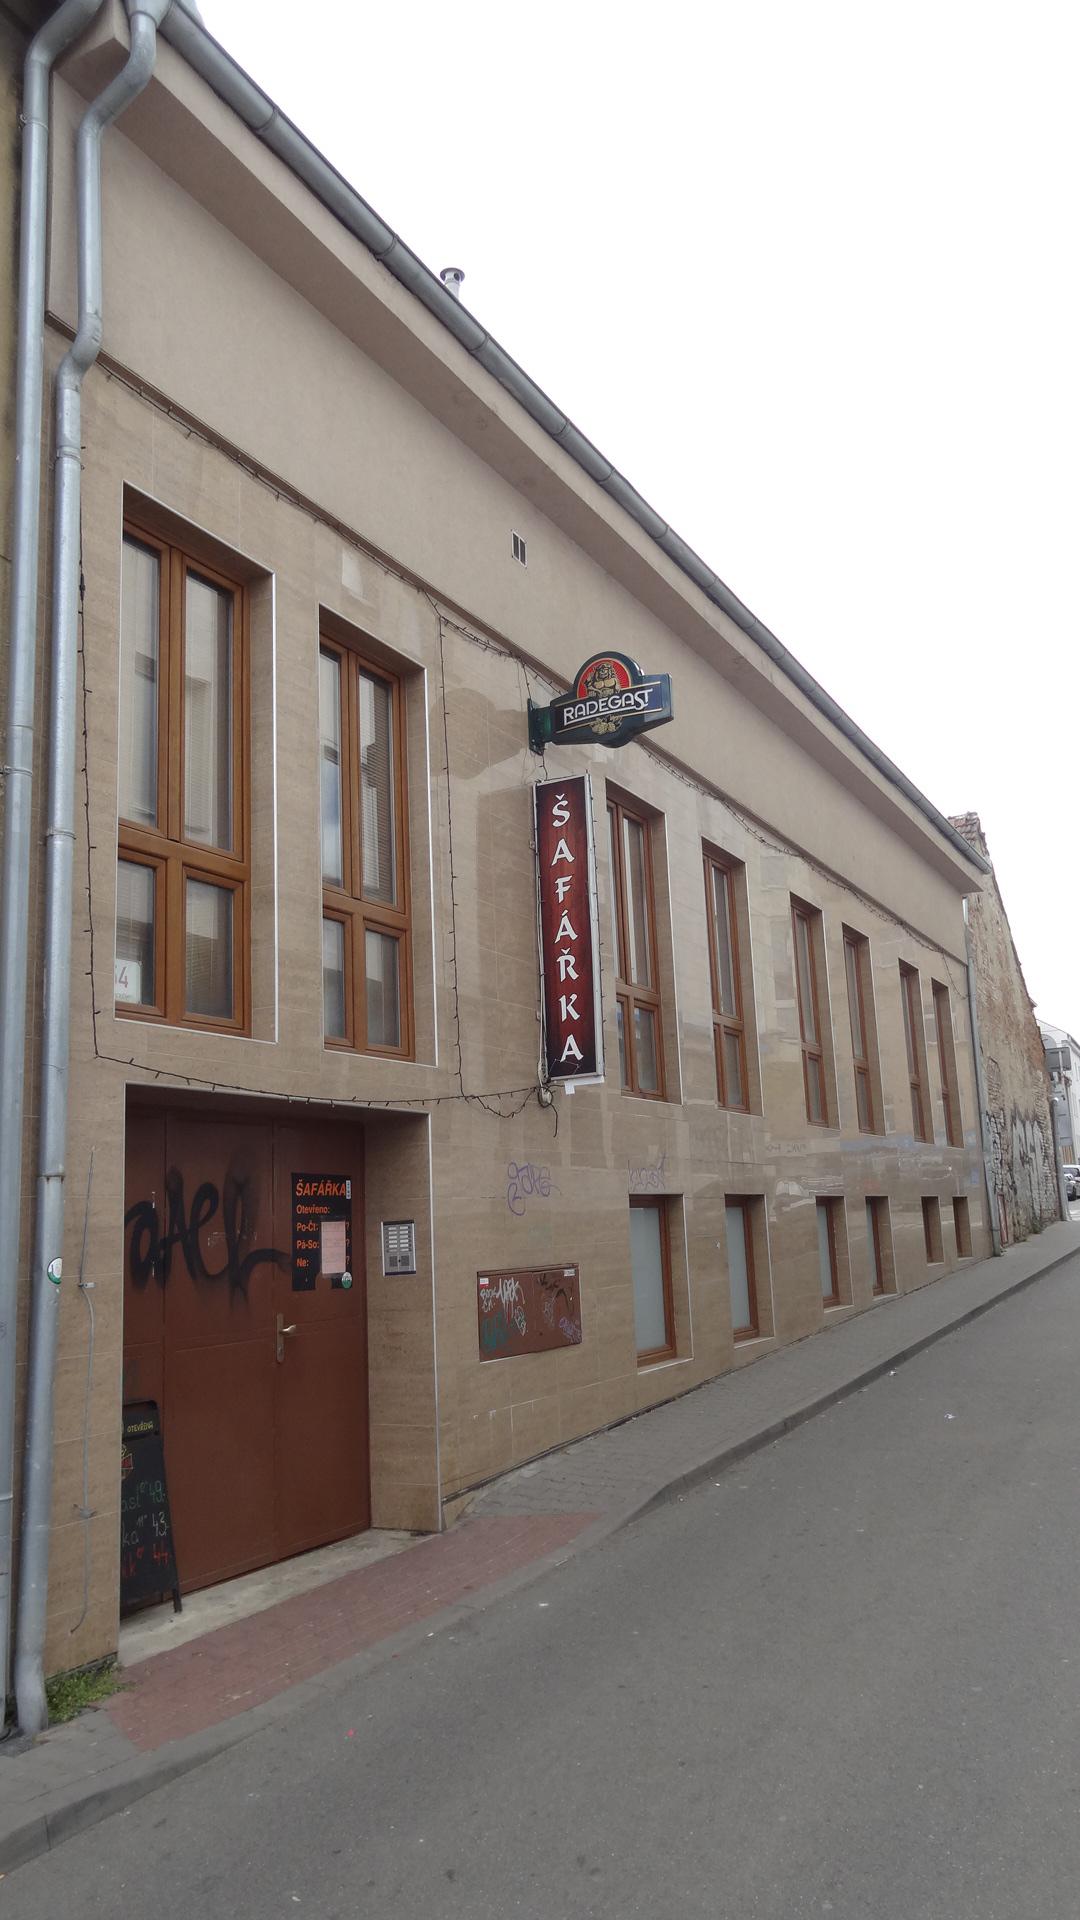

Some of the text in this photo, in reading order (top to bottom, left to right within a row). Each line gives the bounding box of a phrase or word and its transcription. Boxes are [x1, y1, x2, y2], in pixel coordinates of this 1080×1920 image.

[564, 688, 653, 725] RADEGAST
[551, 793, 584, 1063] ŠAFÁŘKA
[296, 1179, 346, 1196] ŠAFÁŘKA
[296, 1204, 330, 1214] Otevřeno:
